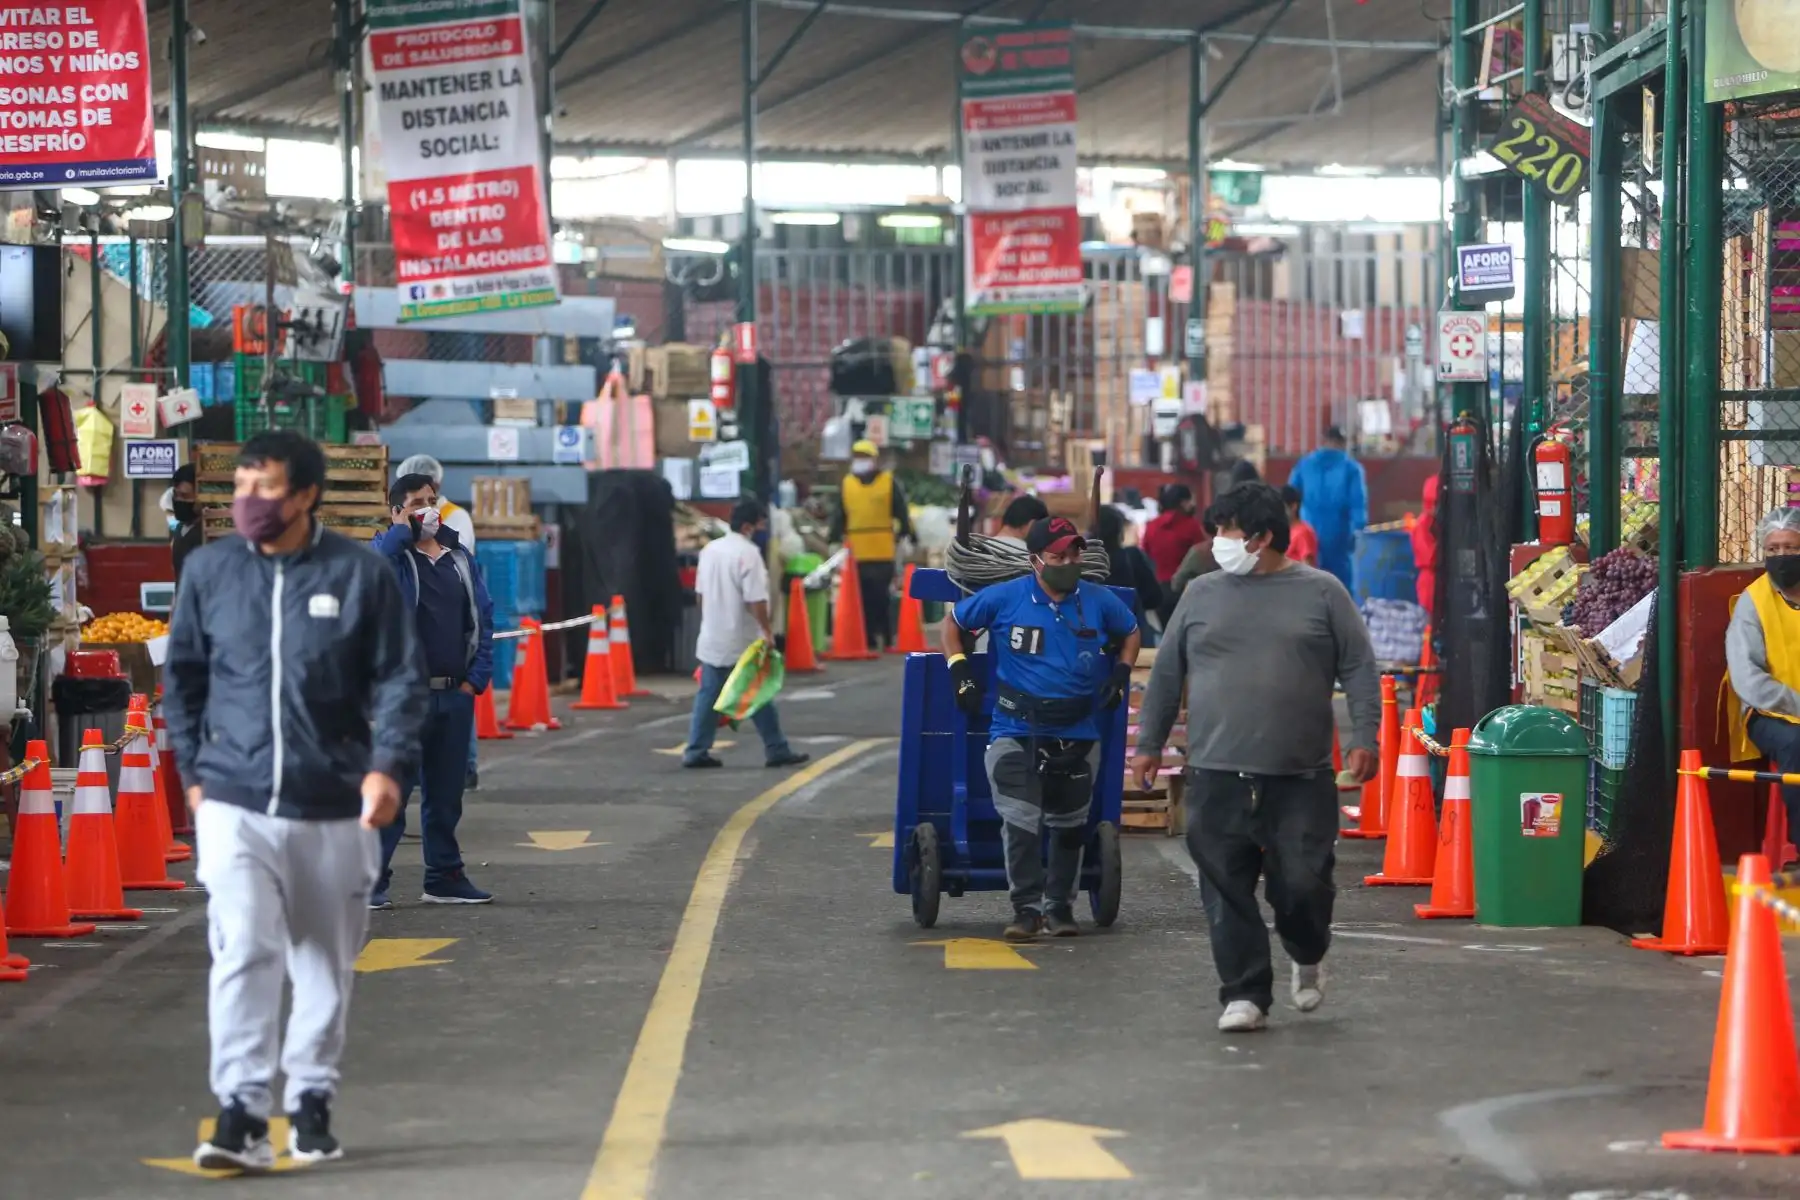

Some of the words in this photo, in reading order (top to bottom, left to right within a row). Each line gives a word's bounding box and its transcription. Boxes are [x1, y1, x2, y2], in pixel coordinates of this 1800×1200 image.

[66, 7, 94, 24] EL
[0, 31, 64, 50] RESO
[68, 30, 99, 48] DE
[396, 25, 497, 47] PROTOCOLO
[48, 55, 64, 73] Y
[70, 49, 140, 72] NIÑOS
[382, 52, 405, 66] DE
[81, 83, 128, 101] CON
[380, 71, 493, 101] MANTENER
[498, 68, 523, 88] LA
[82, 108, 112, 126] DE
[402, 100, 509, 130] DISTANCIA
[420, 133, 500, 159] SOCIAL:
[1493, 118, 1582, 194] 220
[410, 187, 445, 210] (1.5
[449, 180, 519, 202] METRO)
[430, 203, 506, 228] DENTRO
[437, 231, 463, 249] DE
[467, 227, 504, 246] LAS
[400, 244, 546, 277] INSTALACIONES
[1464, 251, 1510, 268] AFORO
[130, 447, 173, 459] AFORO
[1010, 626, 1040, 654] 51
